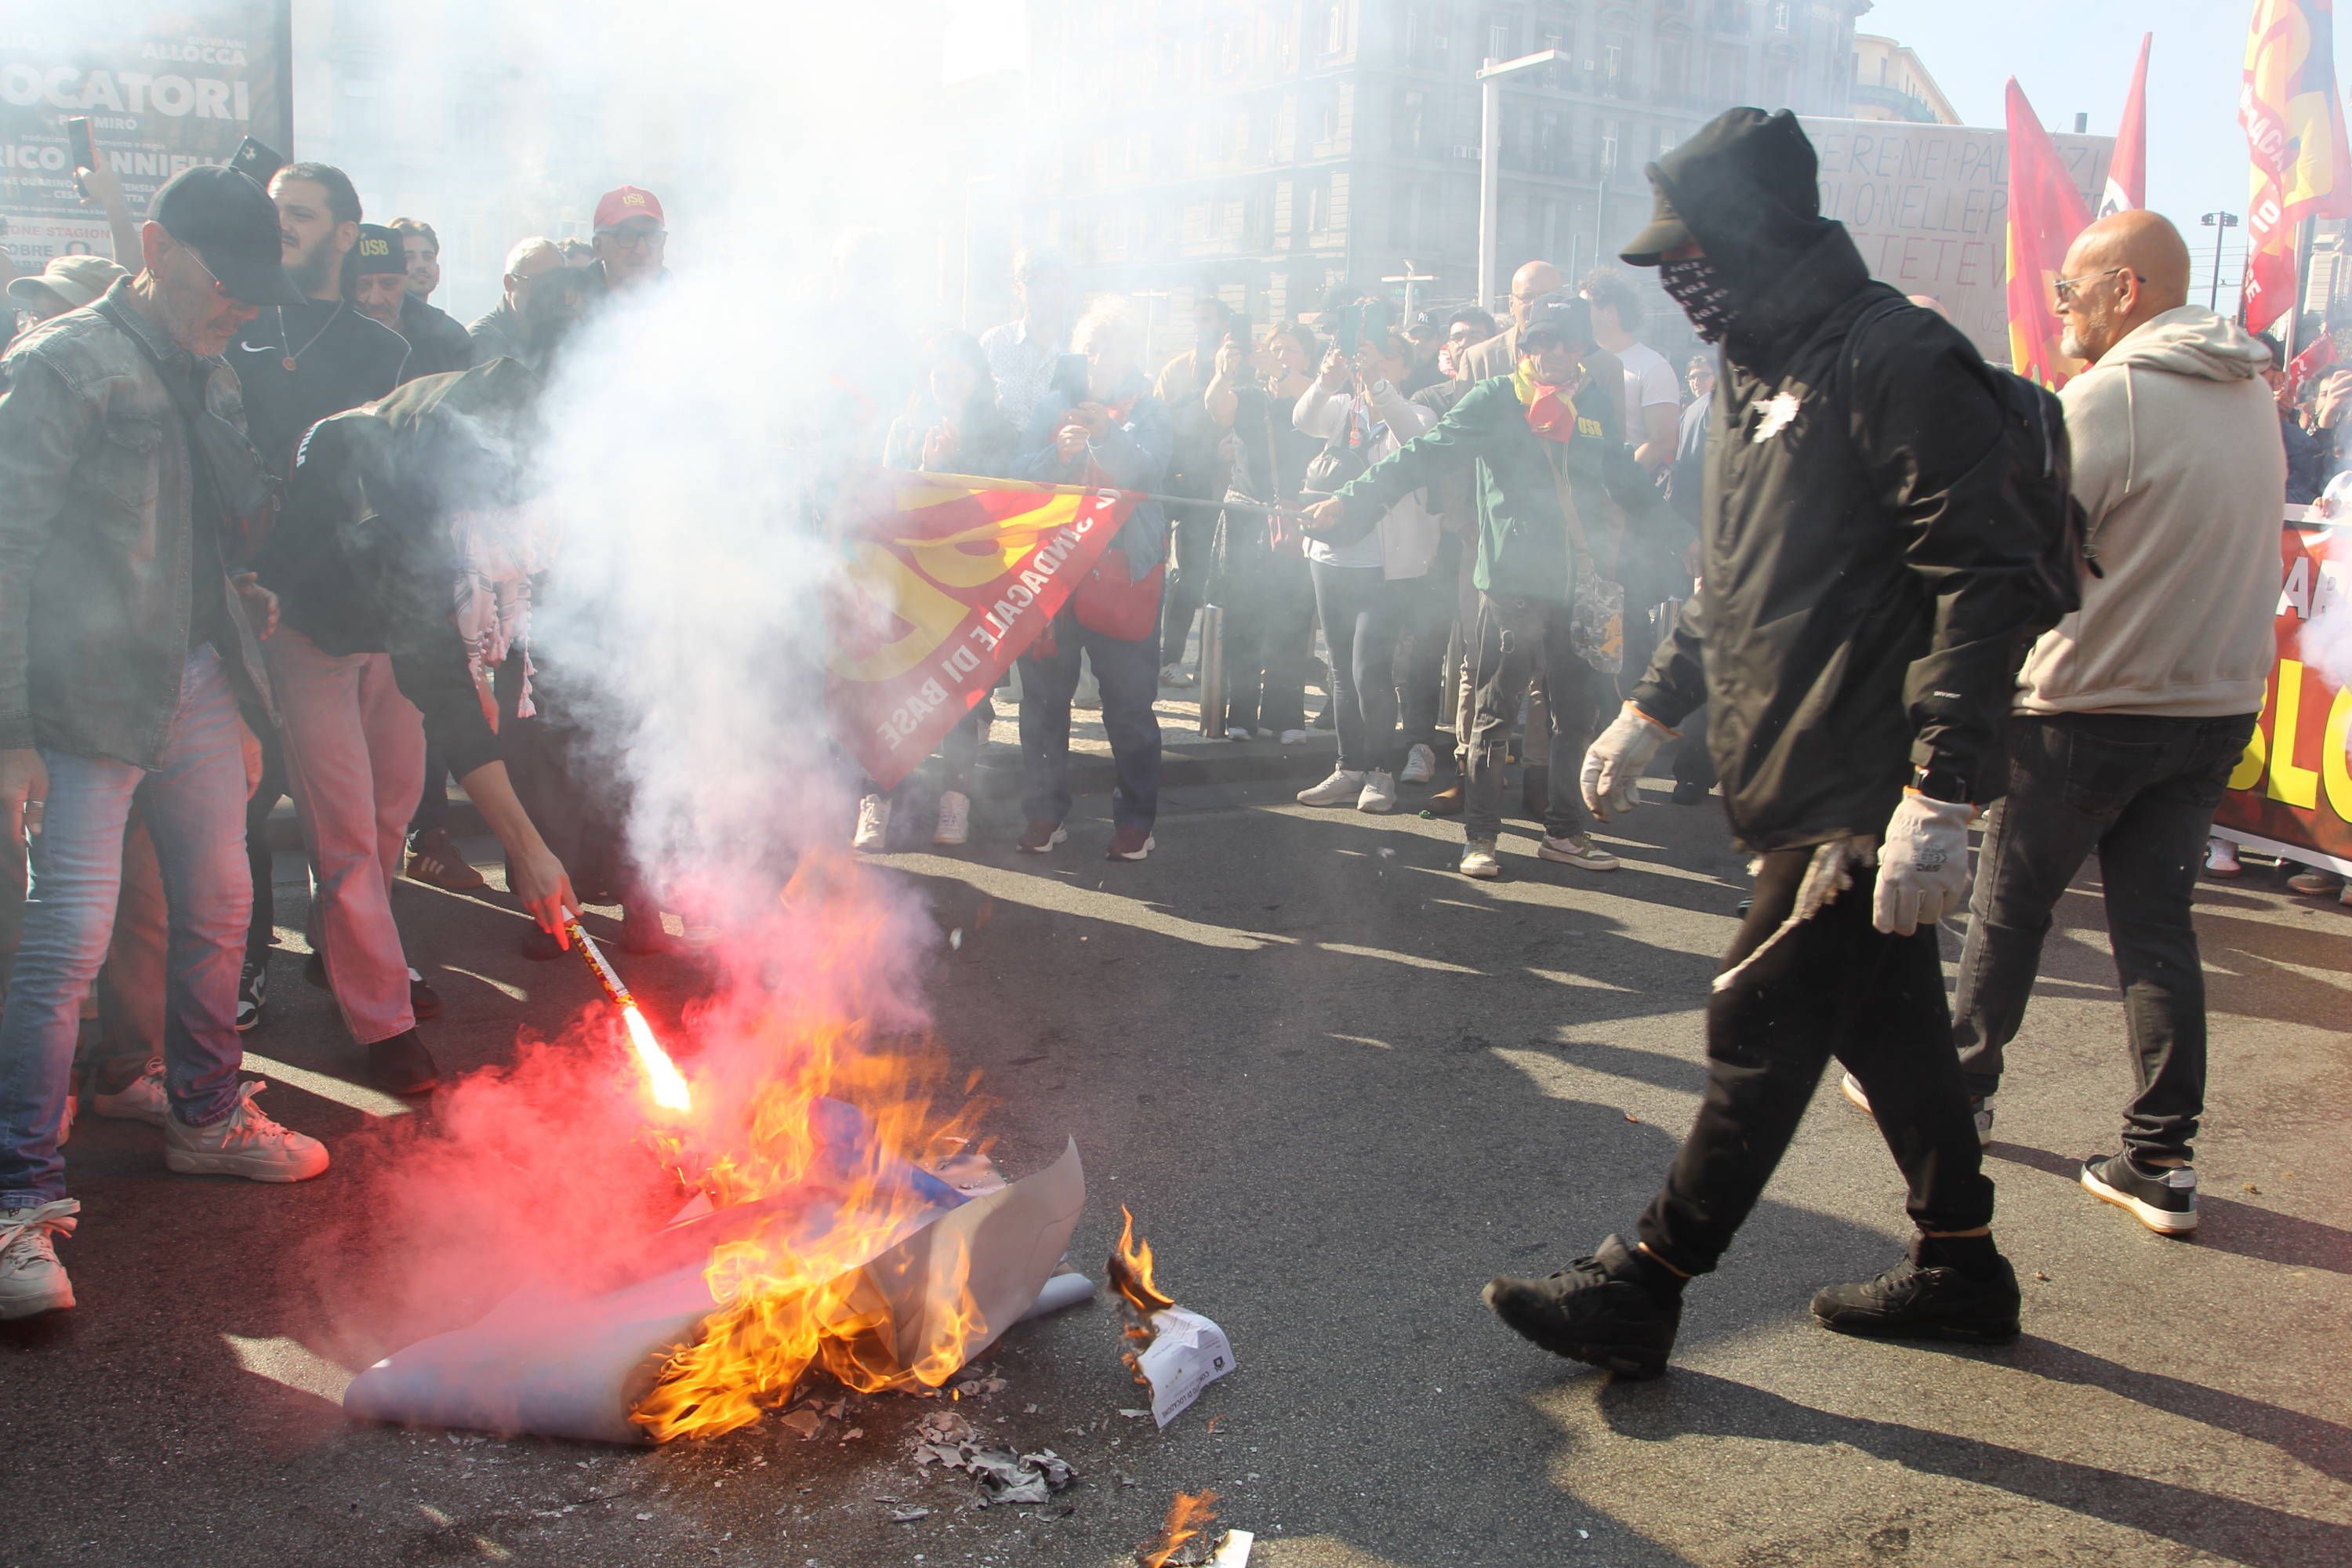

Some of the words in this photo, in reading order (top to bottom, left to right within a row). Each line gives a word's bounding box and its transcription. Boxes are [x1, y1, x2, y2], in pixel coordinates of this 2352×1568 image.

[141, 42, 248, 67] ALLOCCA
[93, 114, 138, 131] MIRÓ
[1809, 131, 1893, 177] ERE
[622, 193, 645, 205] USB
[2251, 198, 2281, 233] DI
[45, 226, 110, 238] STAGION
[358, 238, 390, 257] USB
[1577, 416, 1603, 437] USB
